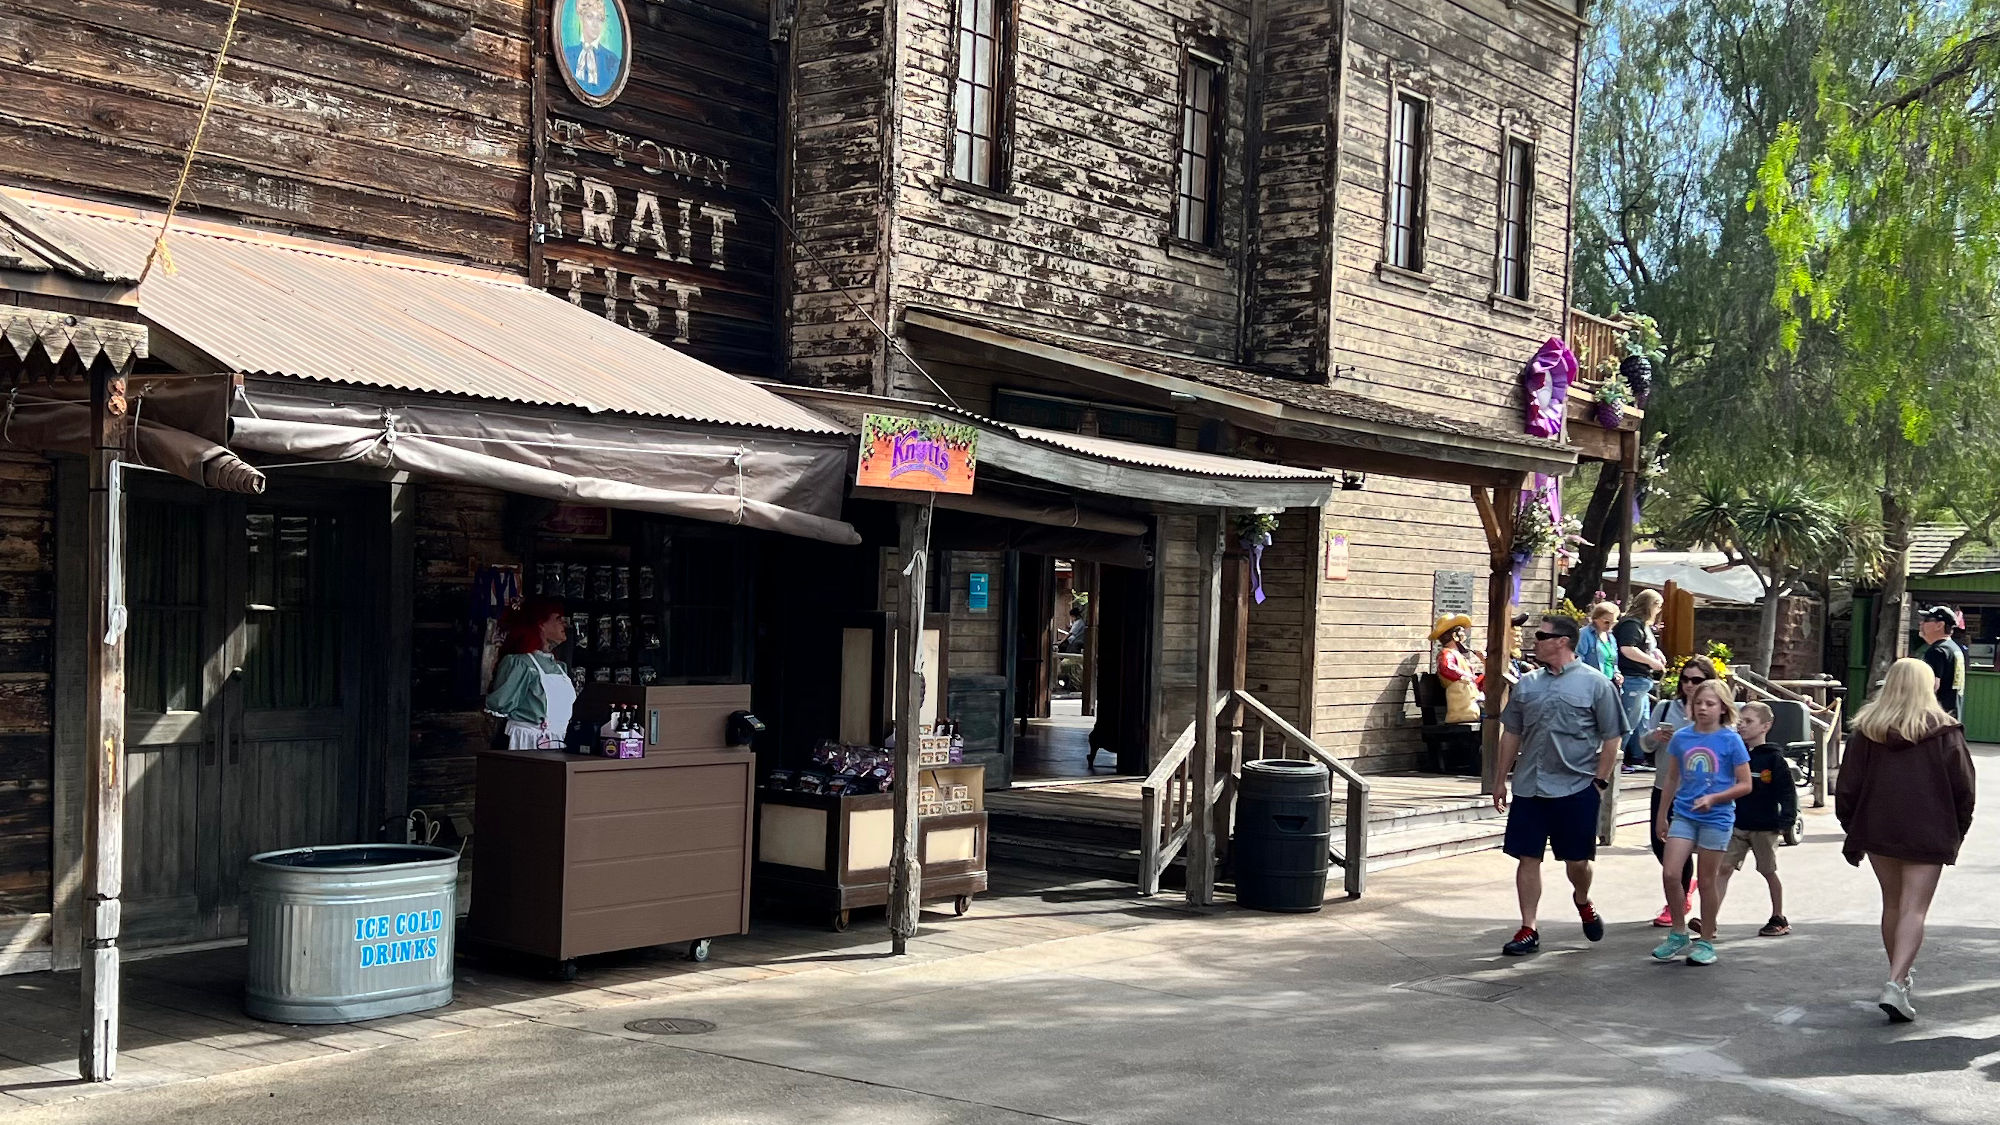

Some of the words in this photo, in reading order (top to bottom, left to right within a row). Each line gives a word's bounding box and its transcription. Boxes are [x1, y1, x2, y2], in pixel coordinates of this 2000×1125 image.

[606, 129, 731, 190] TOWN
[543, 258, 702, 344] TIST
[354, 915, 390, 941] ICE
[395, 909, 443, 936] COLD
[360, 936, 438, 968] DRINKS
